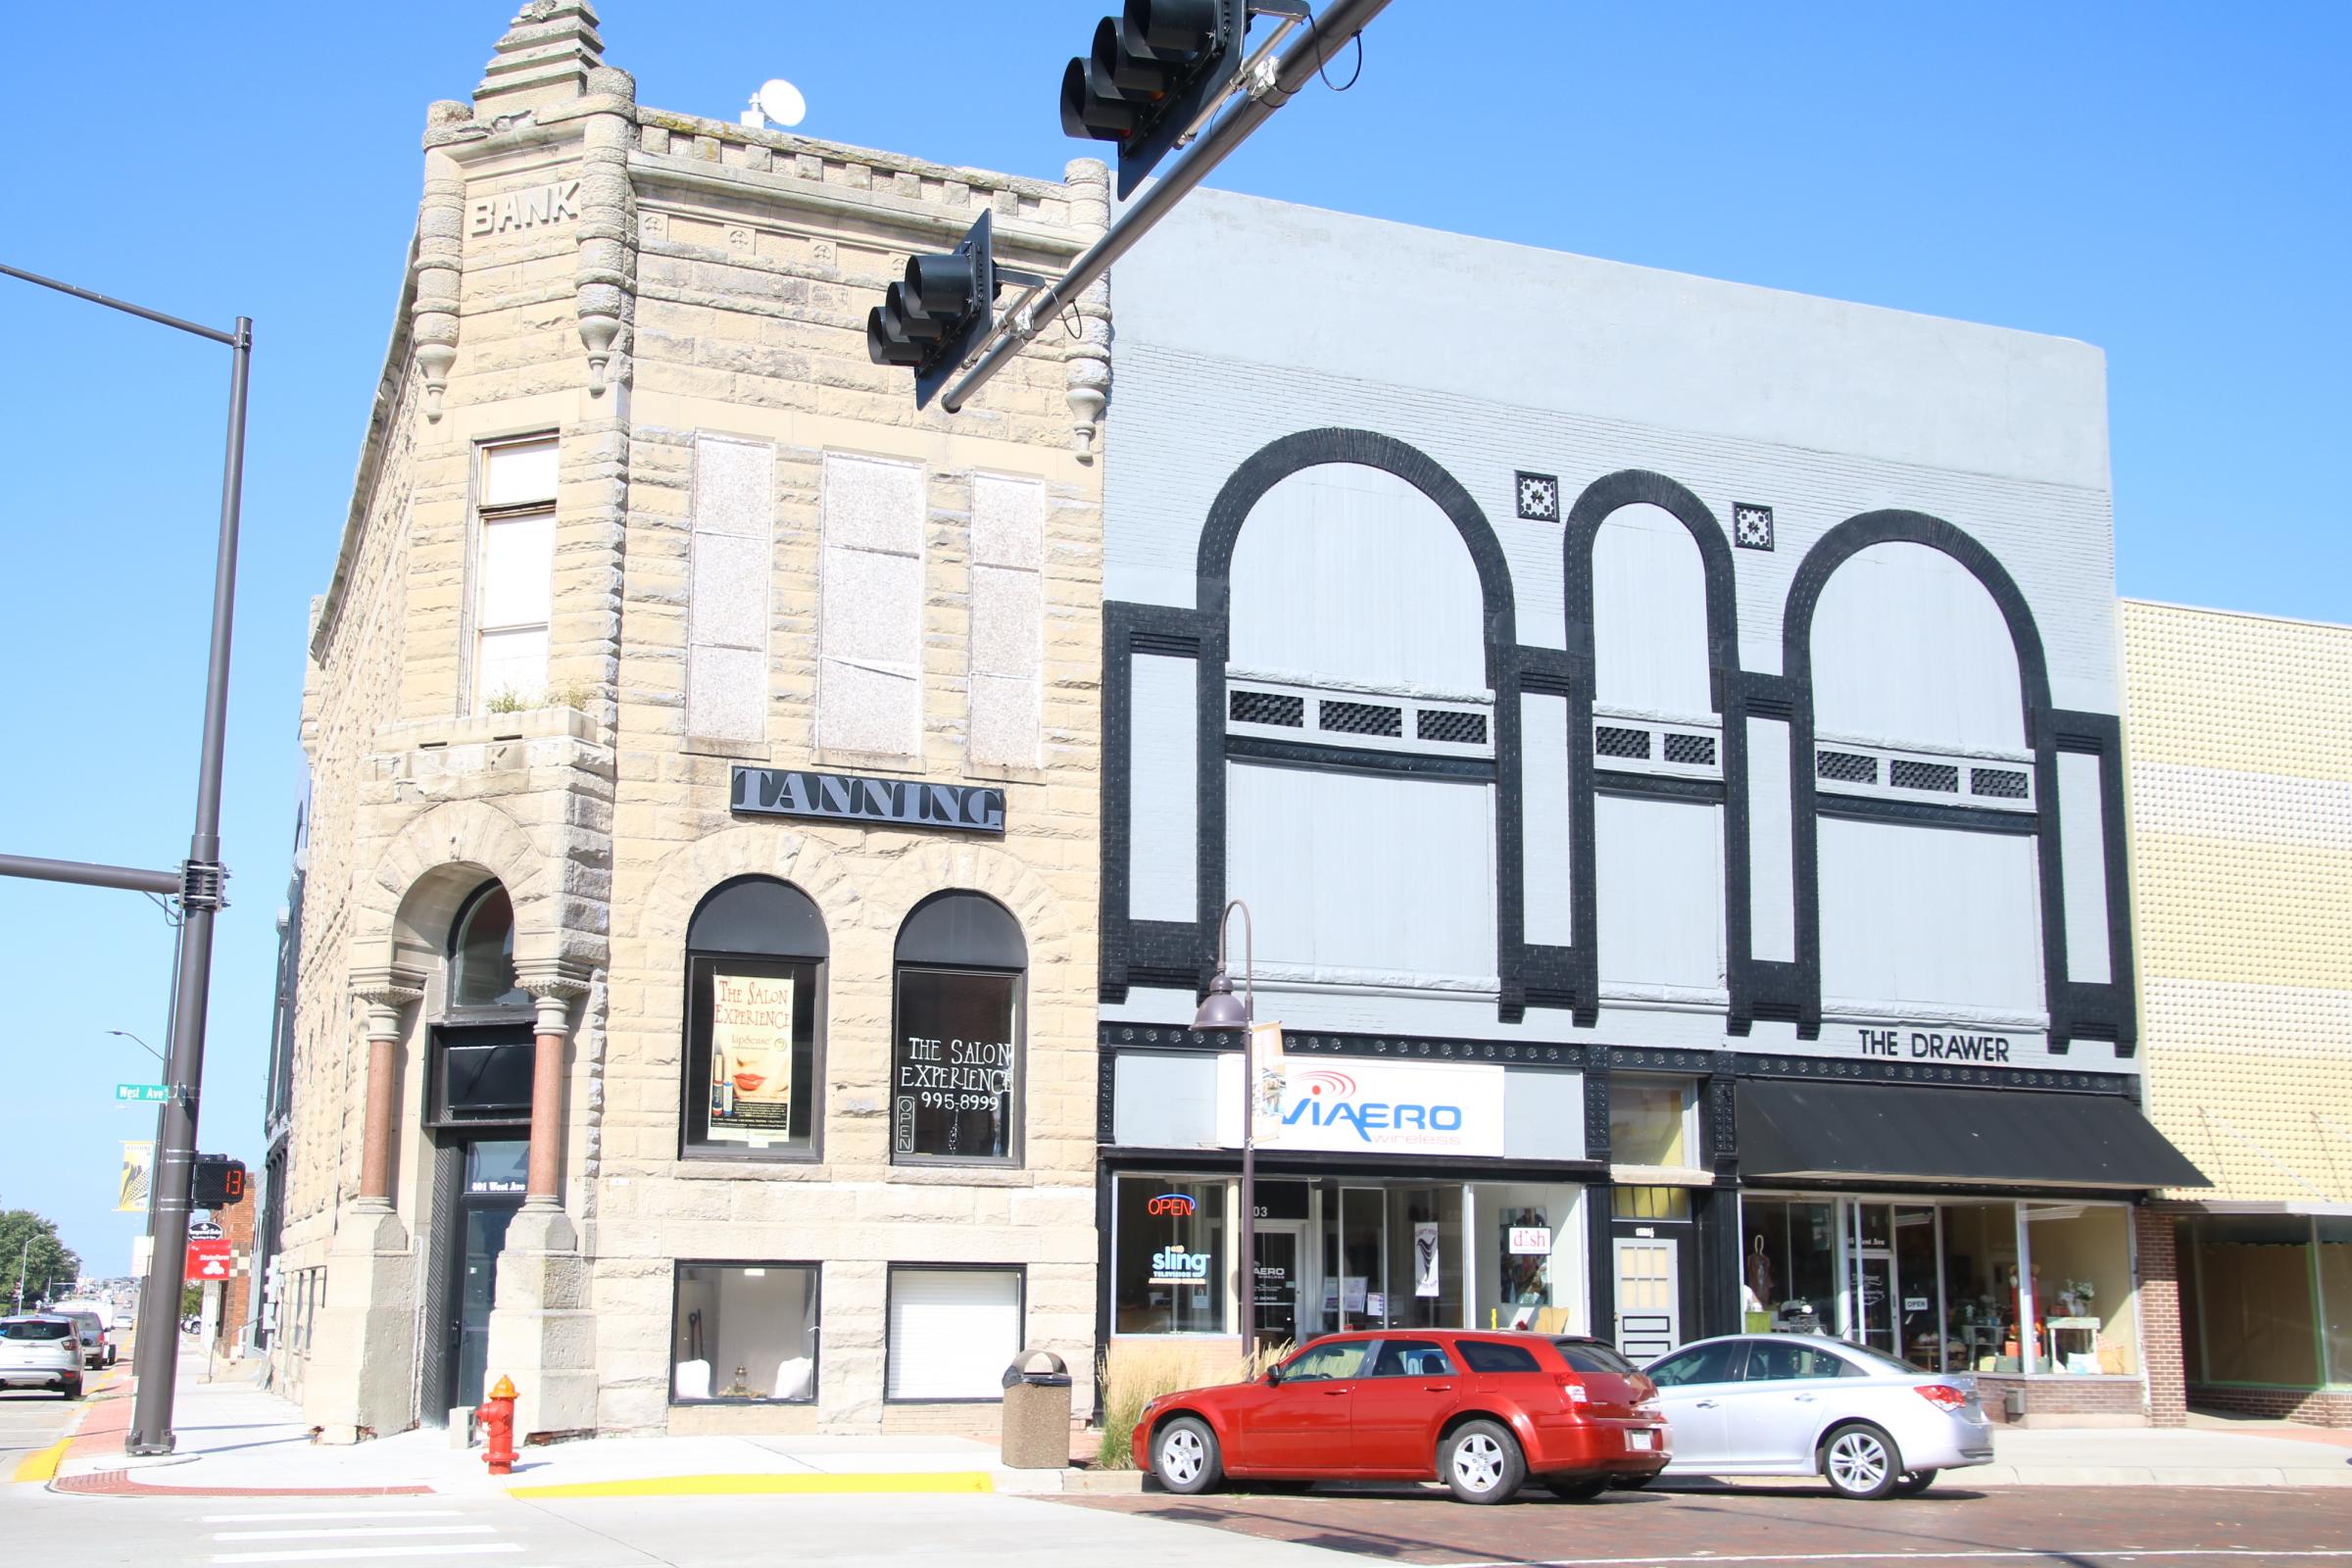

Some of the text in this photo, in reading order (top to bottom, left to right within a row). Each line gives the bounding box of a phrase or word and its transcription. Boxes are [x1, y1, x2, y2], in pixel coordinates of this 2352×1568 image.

[470, 179, 582, 238] BANK
[734, 767, 1005, 831] TANNING
[719, 980, 788, 1005] THE SALON
[713, 1004, 790, 1029] EXPERIENCE
[908, 1037, 1011, 1066] THE SALON
[1858, 1029, 2009, 1062] THE DRAWER
[901, 1064, 1013, 1095] EXPERIENCE
[120, 1086, 164, 1099] West Ave
[921, 1091, 999, 1111] 995-8999
[900, 1099, 912, 1150] OPEN
[1372, 1133, 1461, 1146] wireless
[225, 1169, 242, 1196] 13
[1148, 1198, 1193, 1216] OPEN
[1254, 1205, 1268, 1217] 03
[1513, 1230, 1545, 1248] dish
[1152, 1246, 1211, 1278] sling
[1253, 1267, 1285, 1276] AERO
